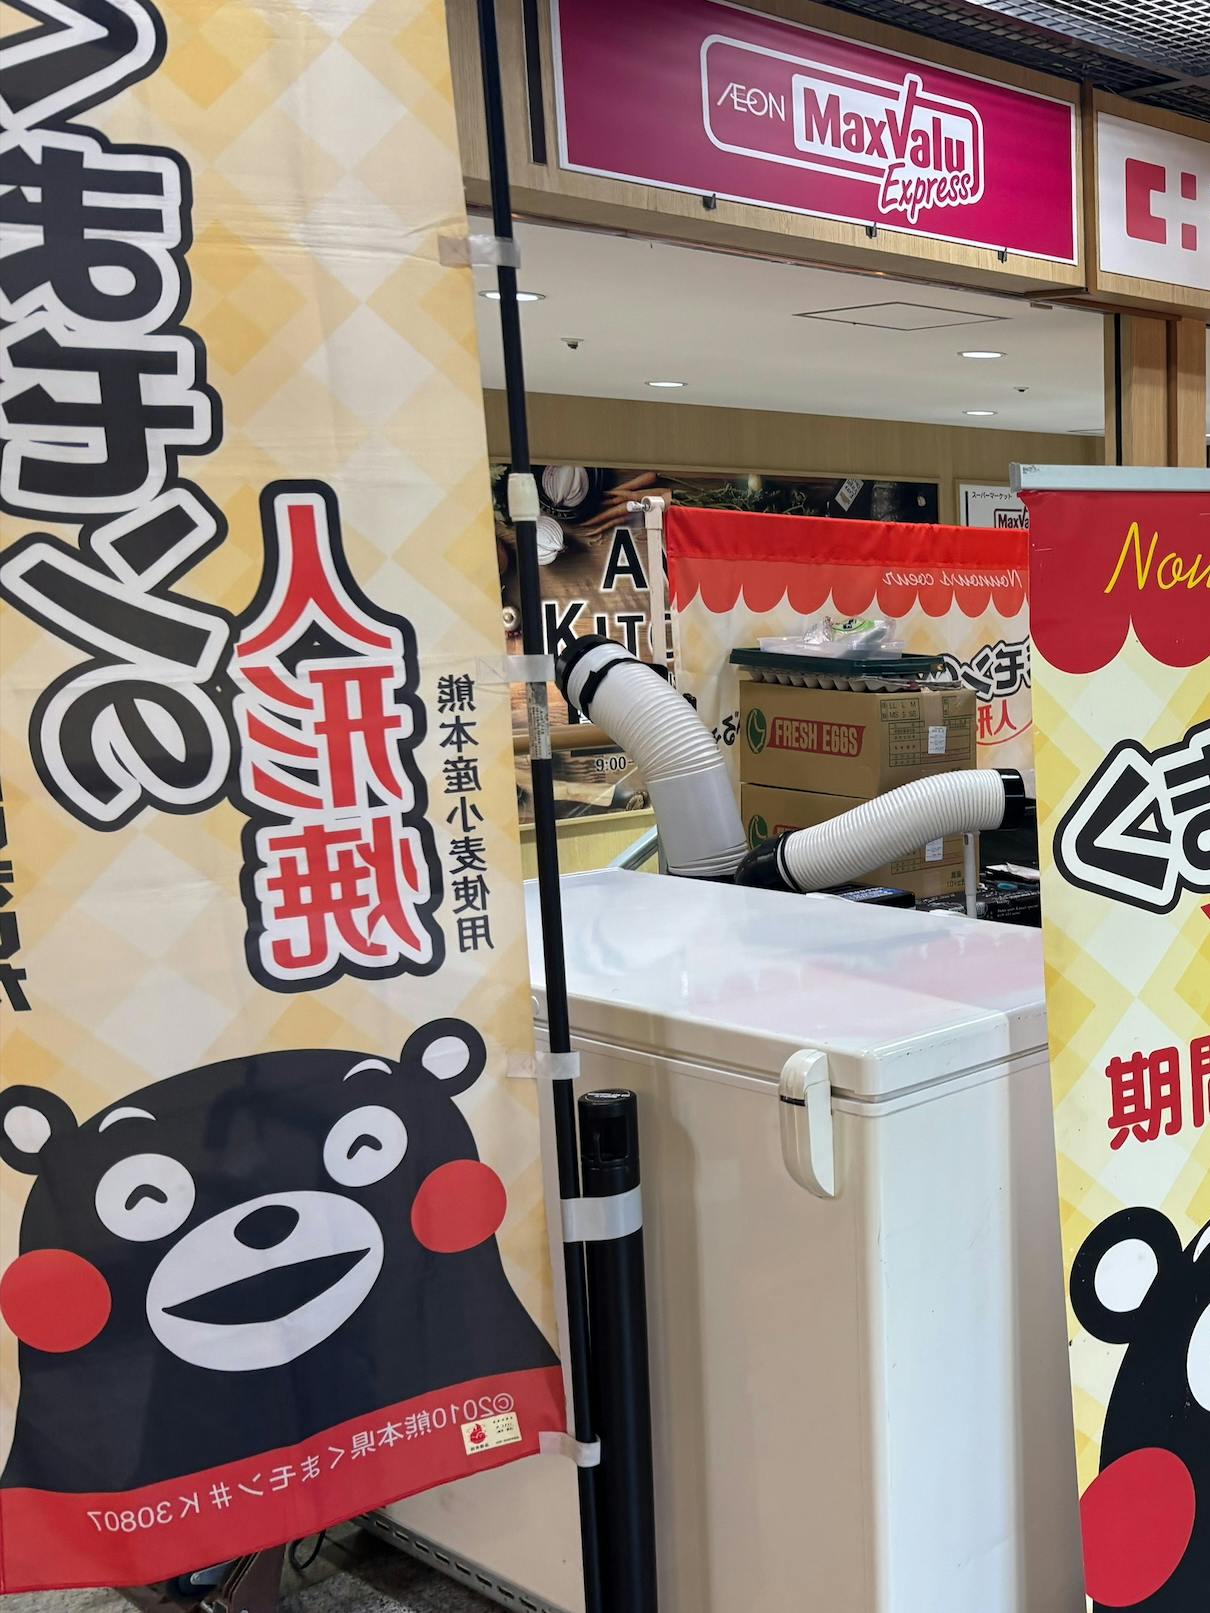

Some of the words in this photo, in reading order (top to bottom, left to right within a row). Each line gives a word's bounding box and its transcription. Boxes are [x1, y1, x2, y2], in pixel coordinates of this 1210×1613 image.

[804, 79, 966, 174] MaxValu
[881, 161, 973, 222] Express
[971, 490, 1013, 501] スーパーマーケット
[775, 719, 817, 750] FRESH
[823, 724, 859, 756] EGGS
